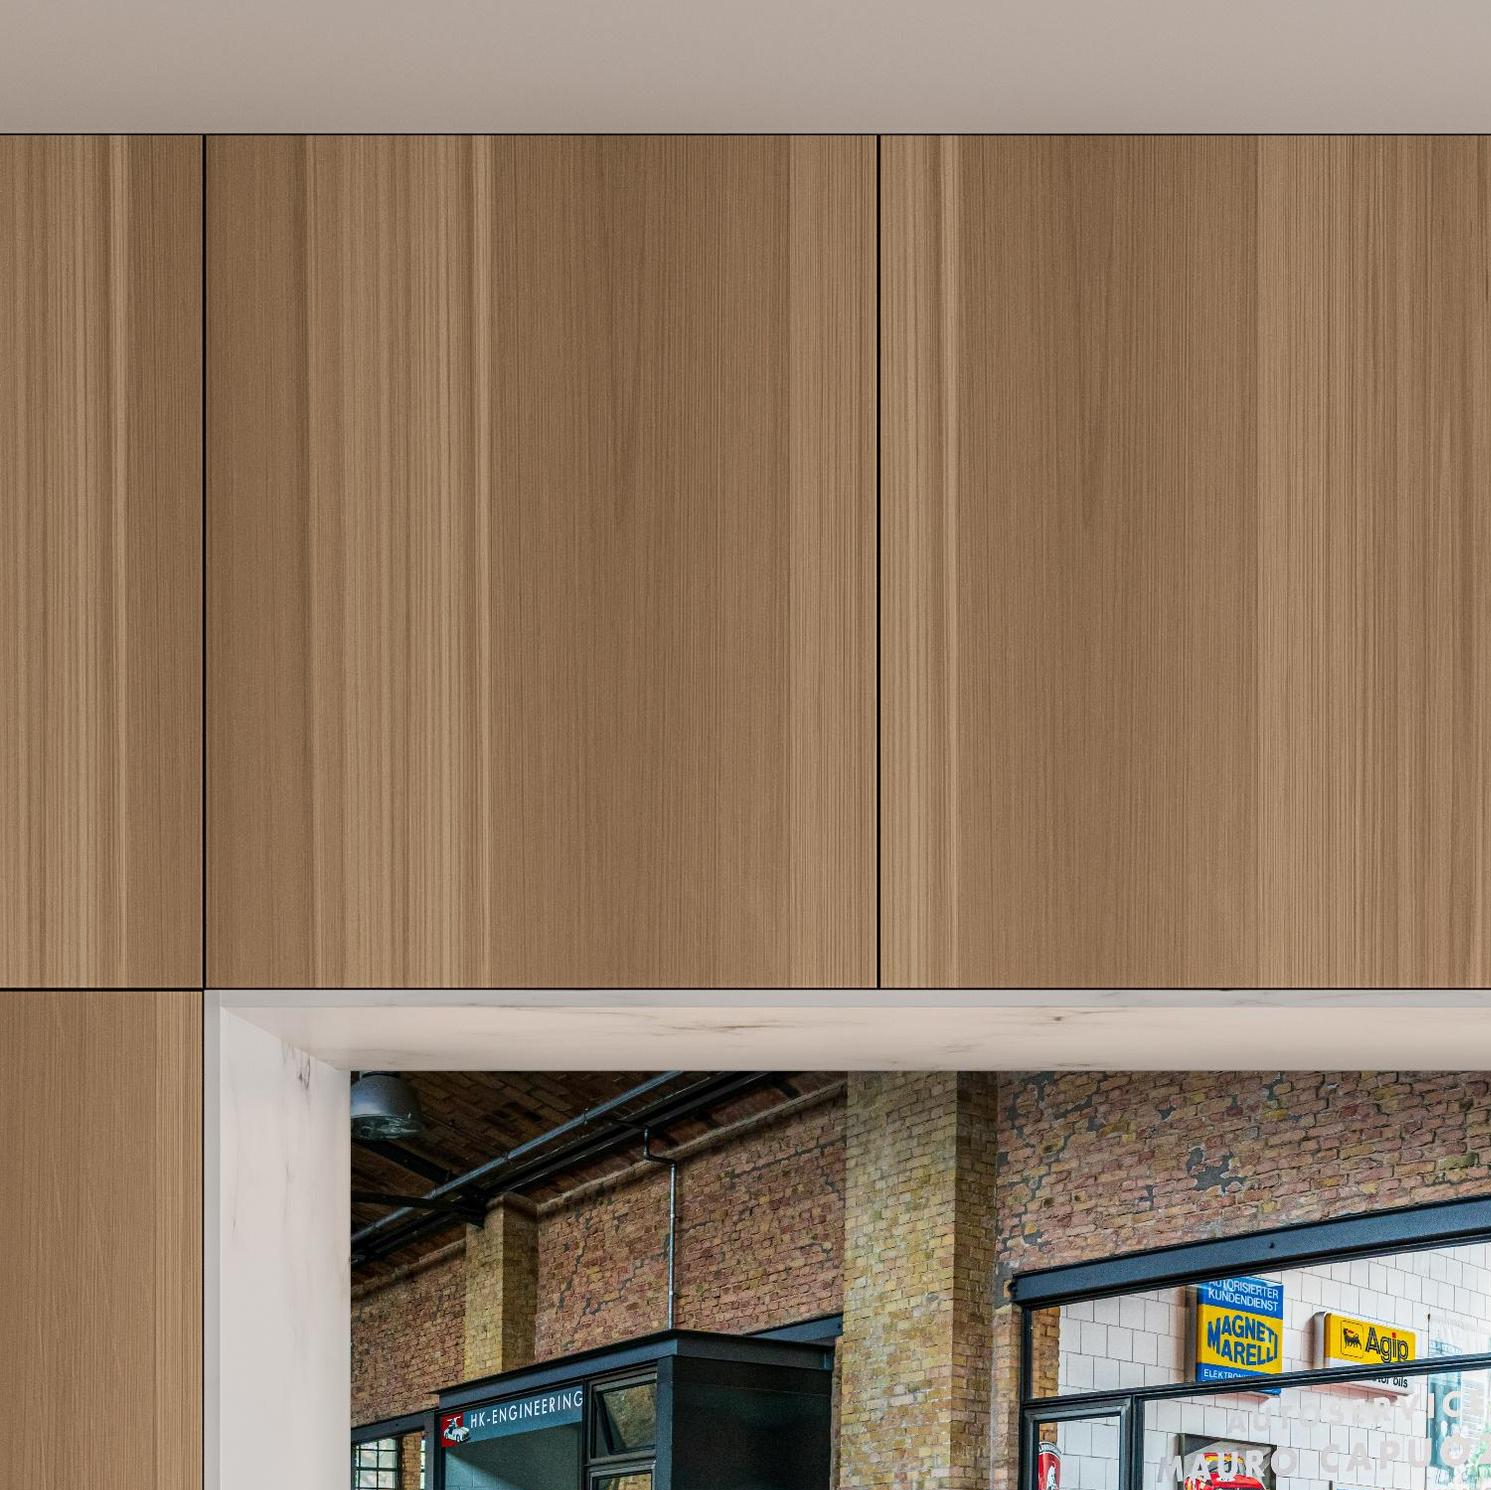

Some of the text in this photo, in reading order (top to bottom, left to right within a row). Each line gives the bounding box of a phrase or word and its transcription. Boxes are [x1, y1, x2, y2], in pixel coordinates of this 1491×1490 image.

[1208, 1288, 1279, 1312] KUNDENDIENST
[1207, 1314, 1279, 1349] MAGNETI
[1365, 1327, 1409, 1363] Agip
[1209, 1334, 1279, 1366] MARELLI
[470, 1390, 583, 1429] HK-ENGINEERING
[1157, 1446, 1298, 1483] MAURO
